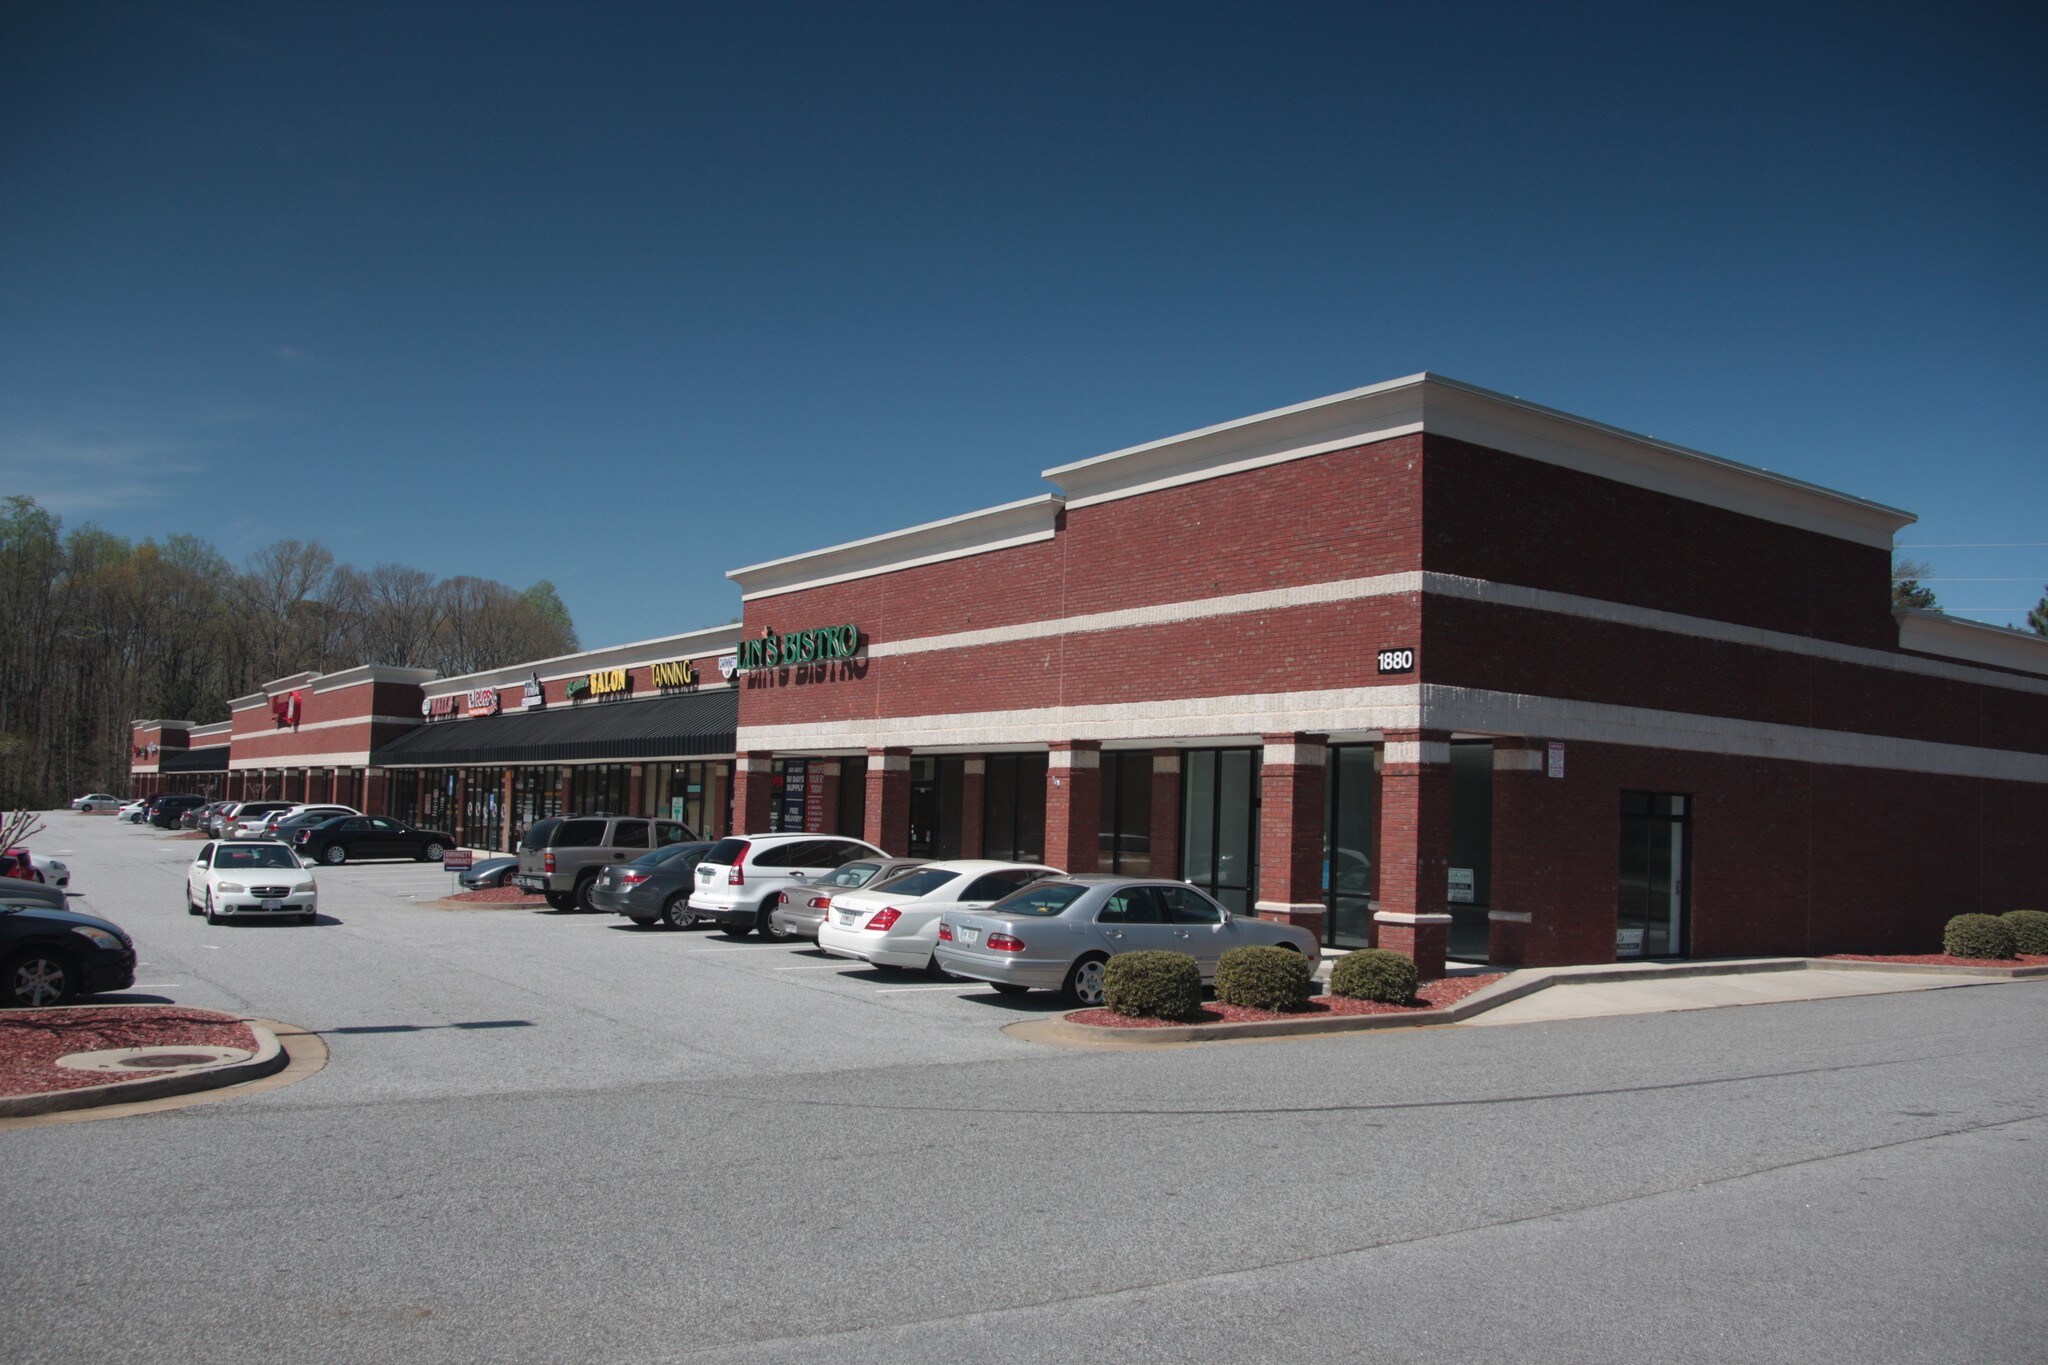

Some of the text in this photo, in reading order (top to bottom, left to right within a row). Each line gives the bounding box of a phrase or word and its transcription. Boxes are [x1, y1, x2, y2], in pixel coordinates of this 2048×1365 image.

[783, 624, 858, 664] BISTRO
[1378, 650, 1412, 670] 1880
[590, 668, 626, 694] SALON
[651, 660, 691, 687] TANNING
[786, 784, 804, 792] SUPPLY
[792, 775, 804, 784] DAYS
